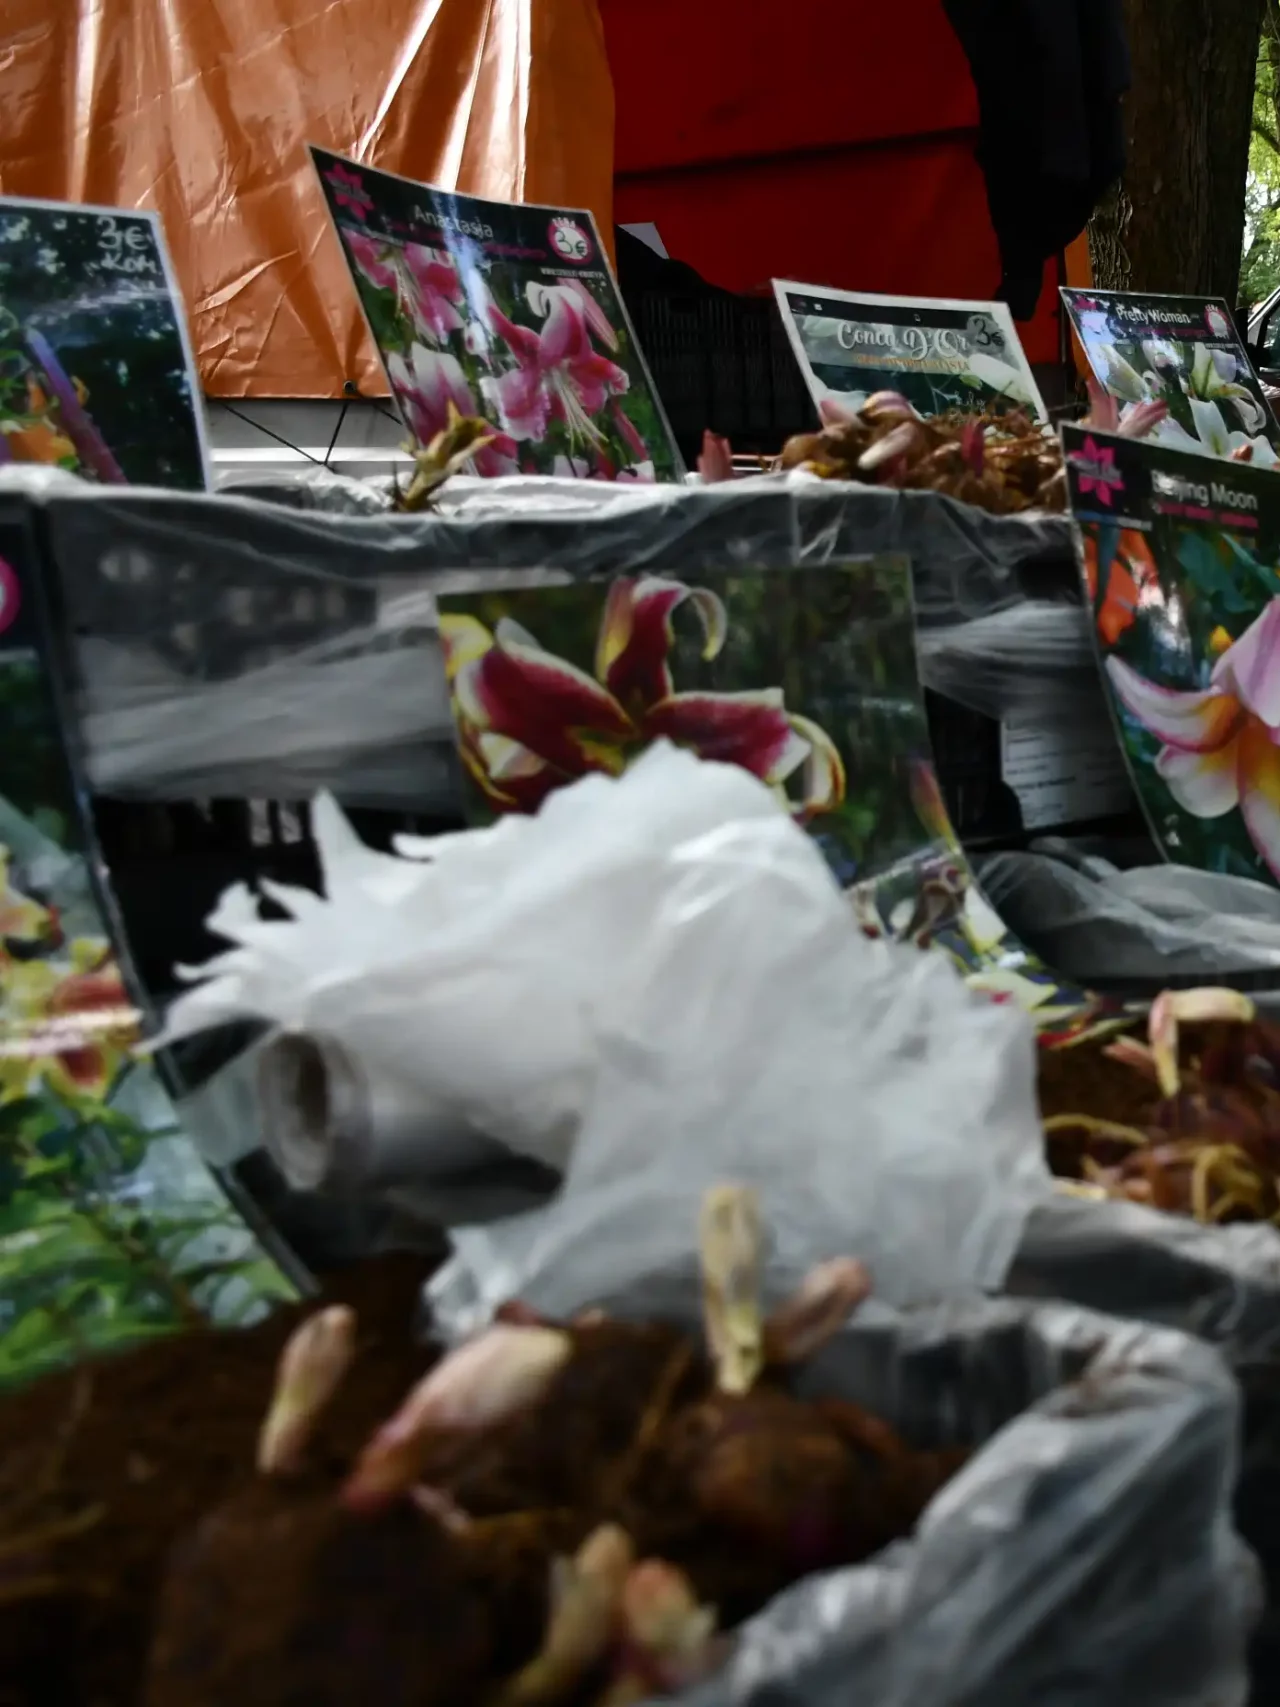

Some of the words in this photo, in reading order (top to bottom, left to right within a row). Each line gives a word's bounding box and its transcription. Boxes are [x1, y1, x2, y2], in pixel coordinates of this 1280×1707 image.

[97, 216, 149, 251] 3€
[1115, 303, 1149, 325] Pretty
[1149, 308, 1192, 324] Woman
[837, 320, 898, 350] Conca
[1210, 481, 1258, 510] Moon
